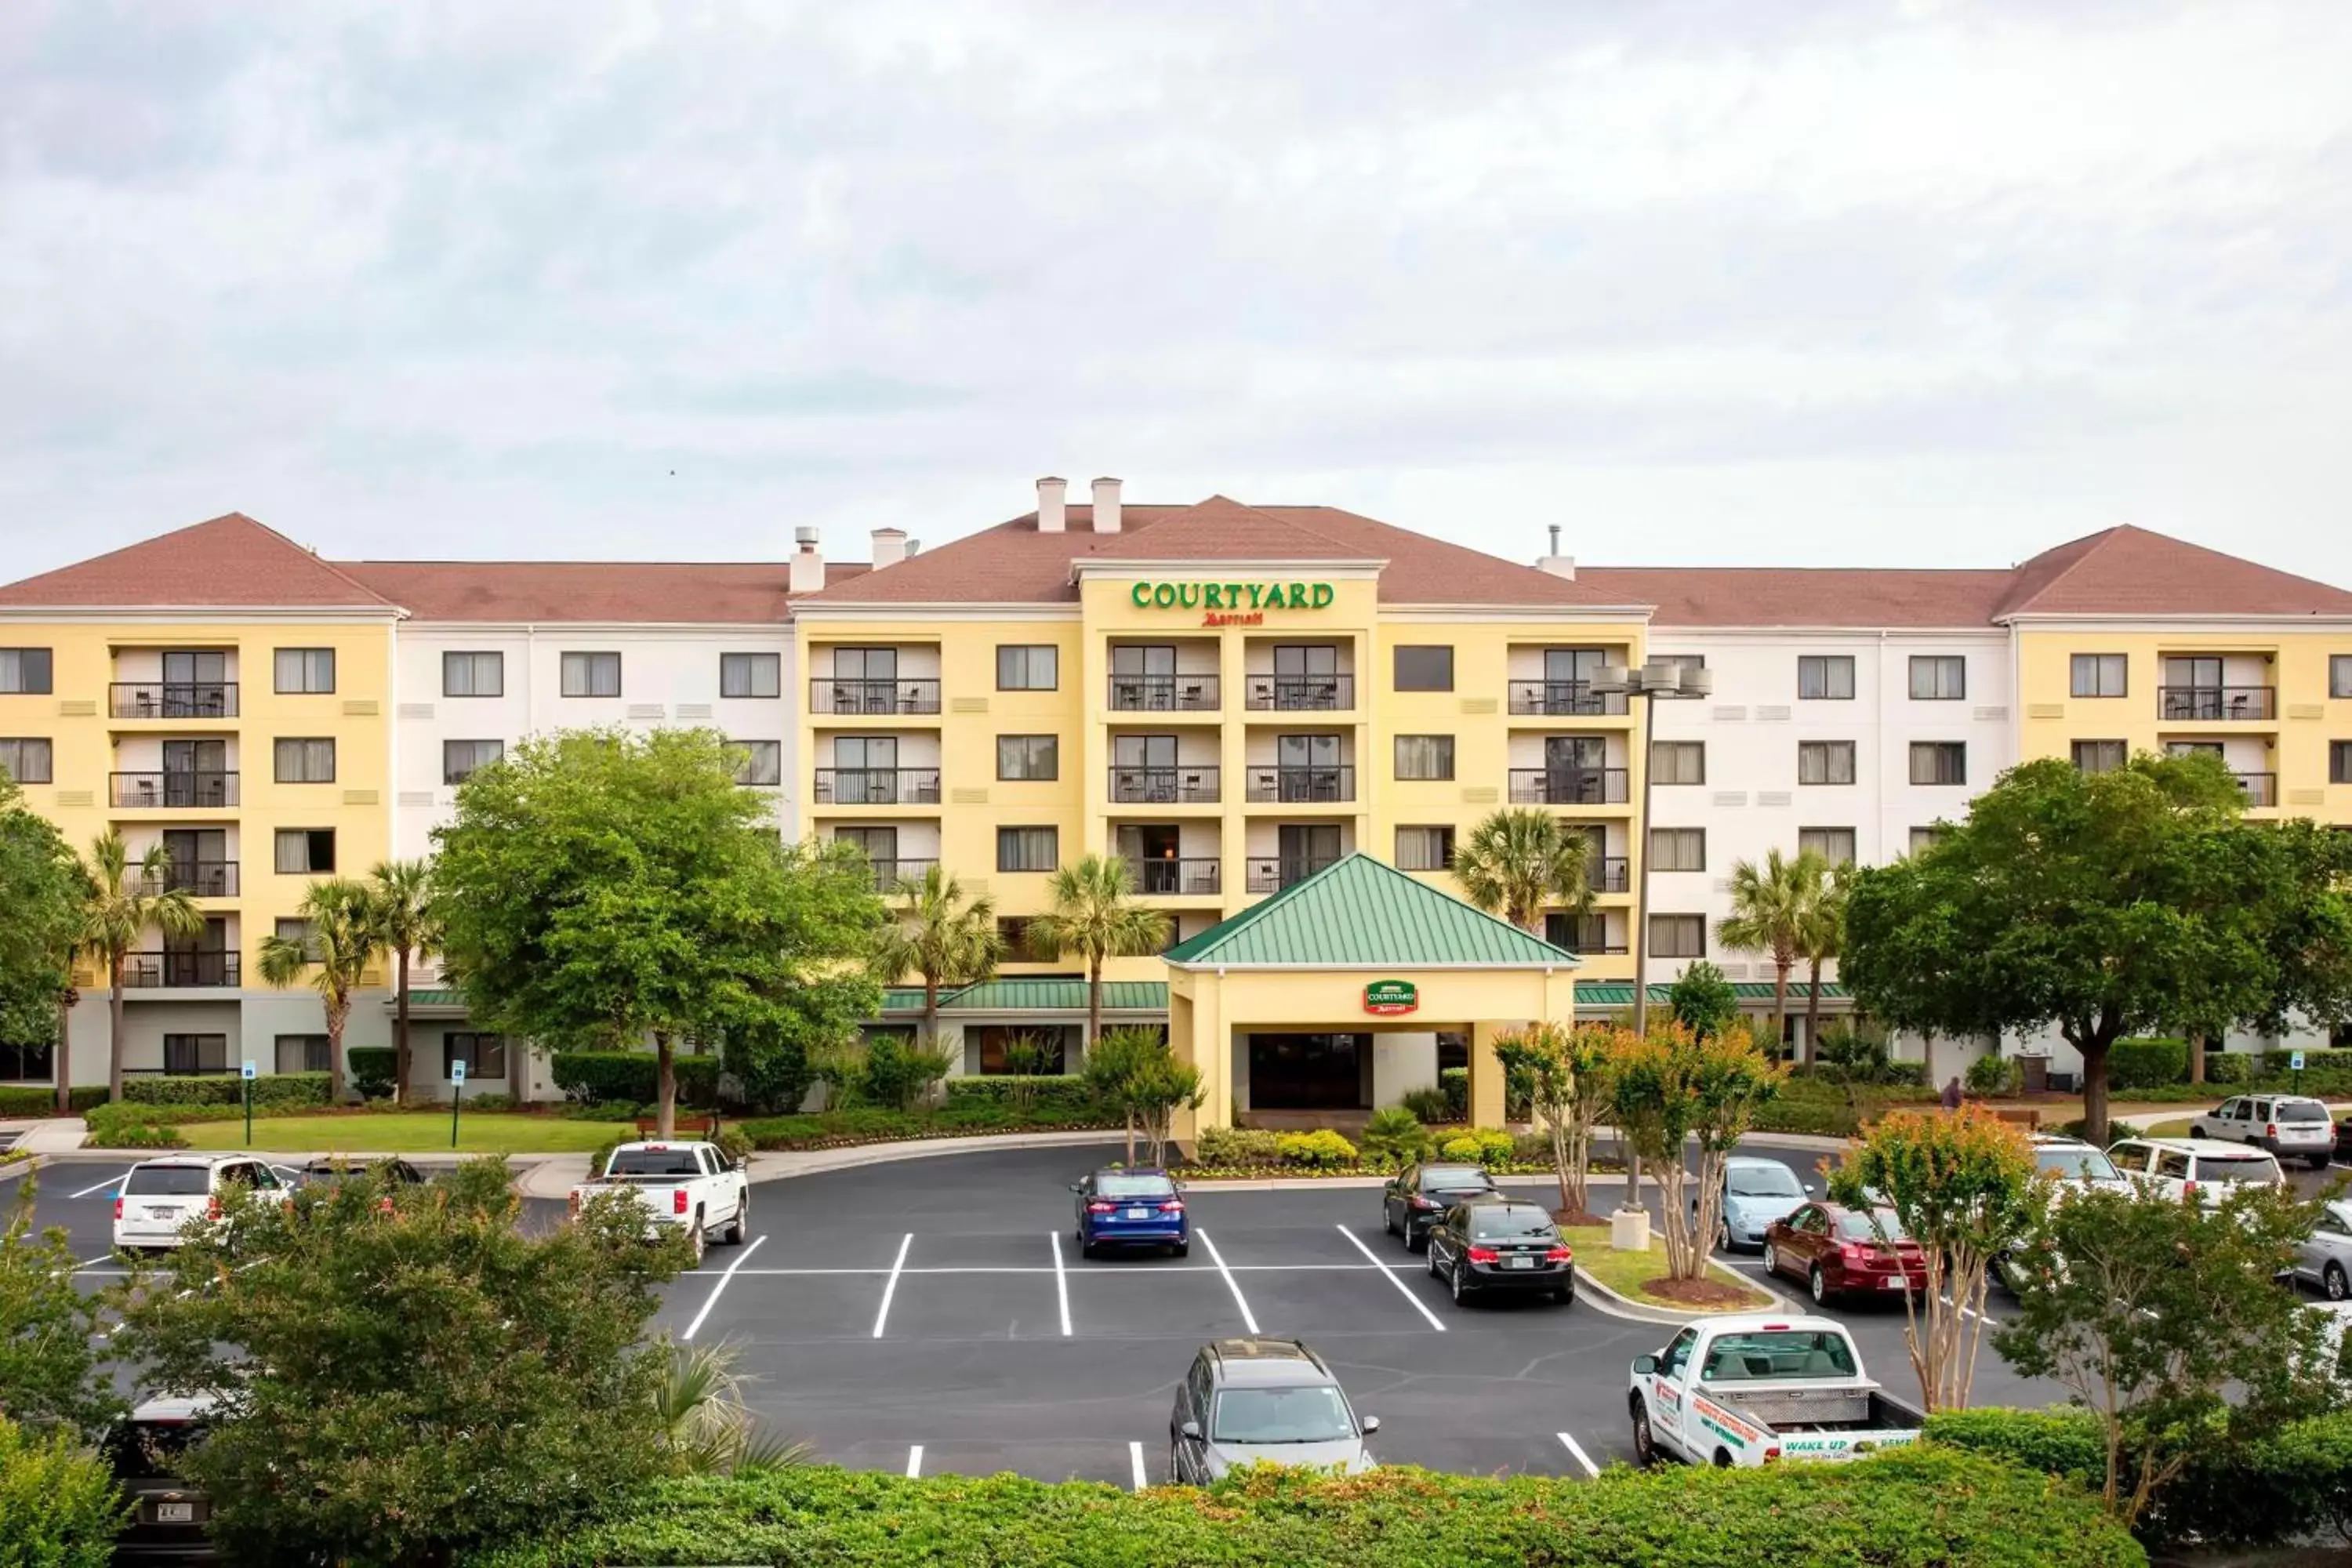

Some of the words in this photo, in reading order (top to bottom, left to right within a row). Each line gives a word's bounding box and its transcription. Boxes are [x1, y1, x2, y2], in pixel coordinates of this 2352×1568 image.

[1132, 582, 1334, 609] COURTYARD
[1202, 612, 1263, 627] Marriott
[1786, 1441, 1824, 1450] WAKE
[1829, 1440, 1848, 1450] UP
